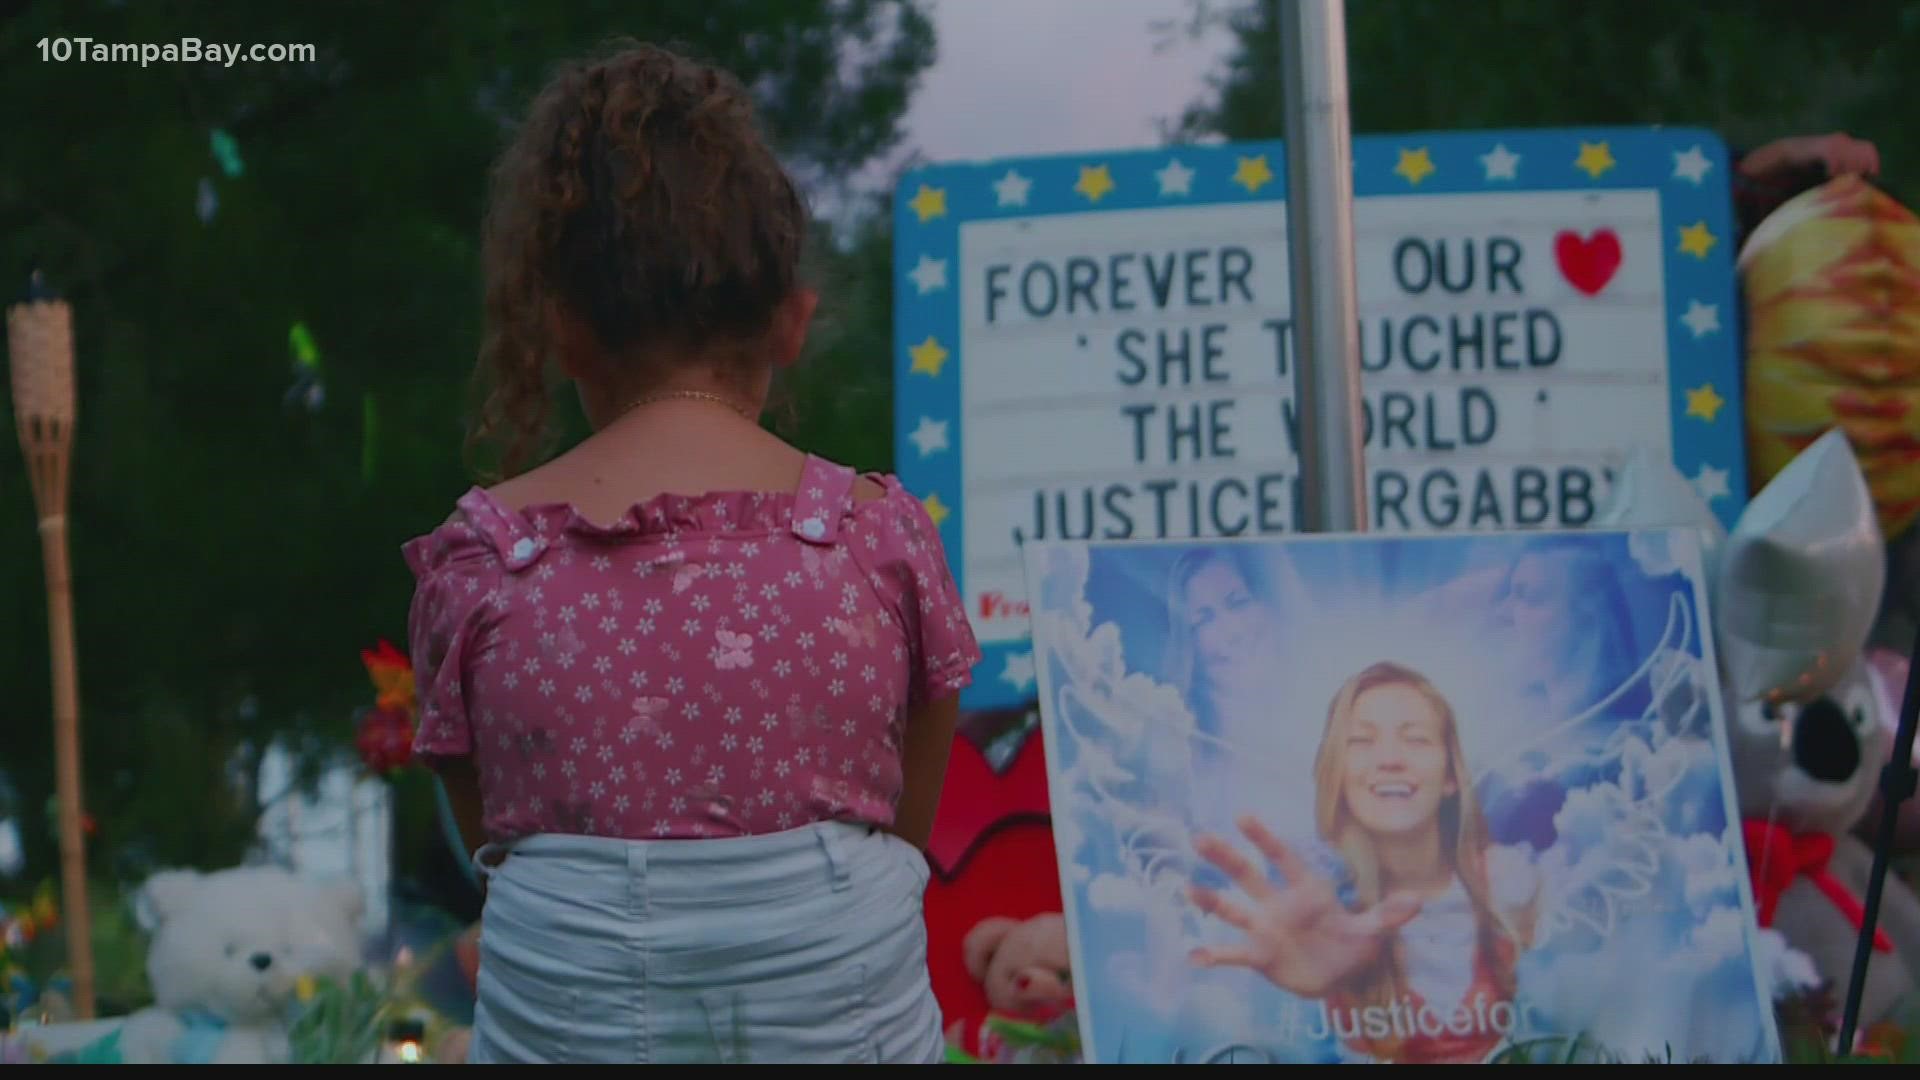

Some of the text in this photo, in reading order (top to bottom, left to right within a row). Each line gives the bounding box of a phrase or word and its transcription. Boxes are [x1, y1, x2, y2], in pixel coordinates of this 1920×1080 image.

[985, 235, 1524, 323] FOREVER OUR
[1115, 328, 1231, 387] SHE
[1262, 309, 1563, 378] TUCHED
[1121, 400, 1235, 462] THE
